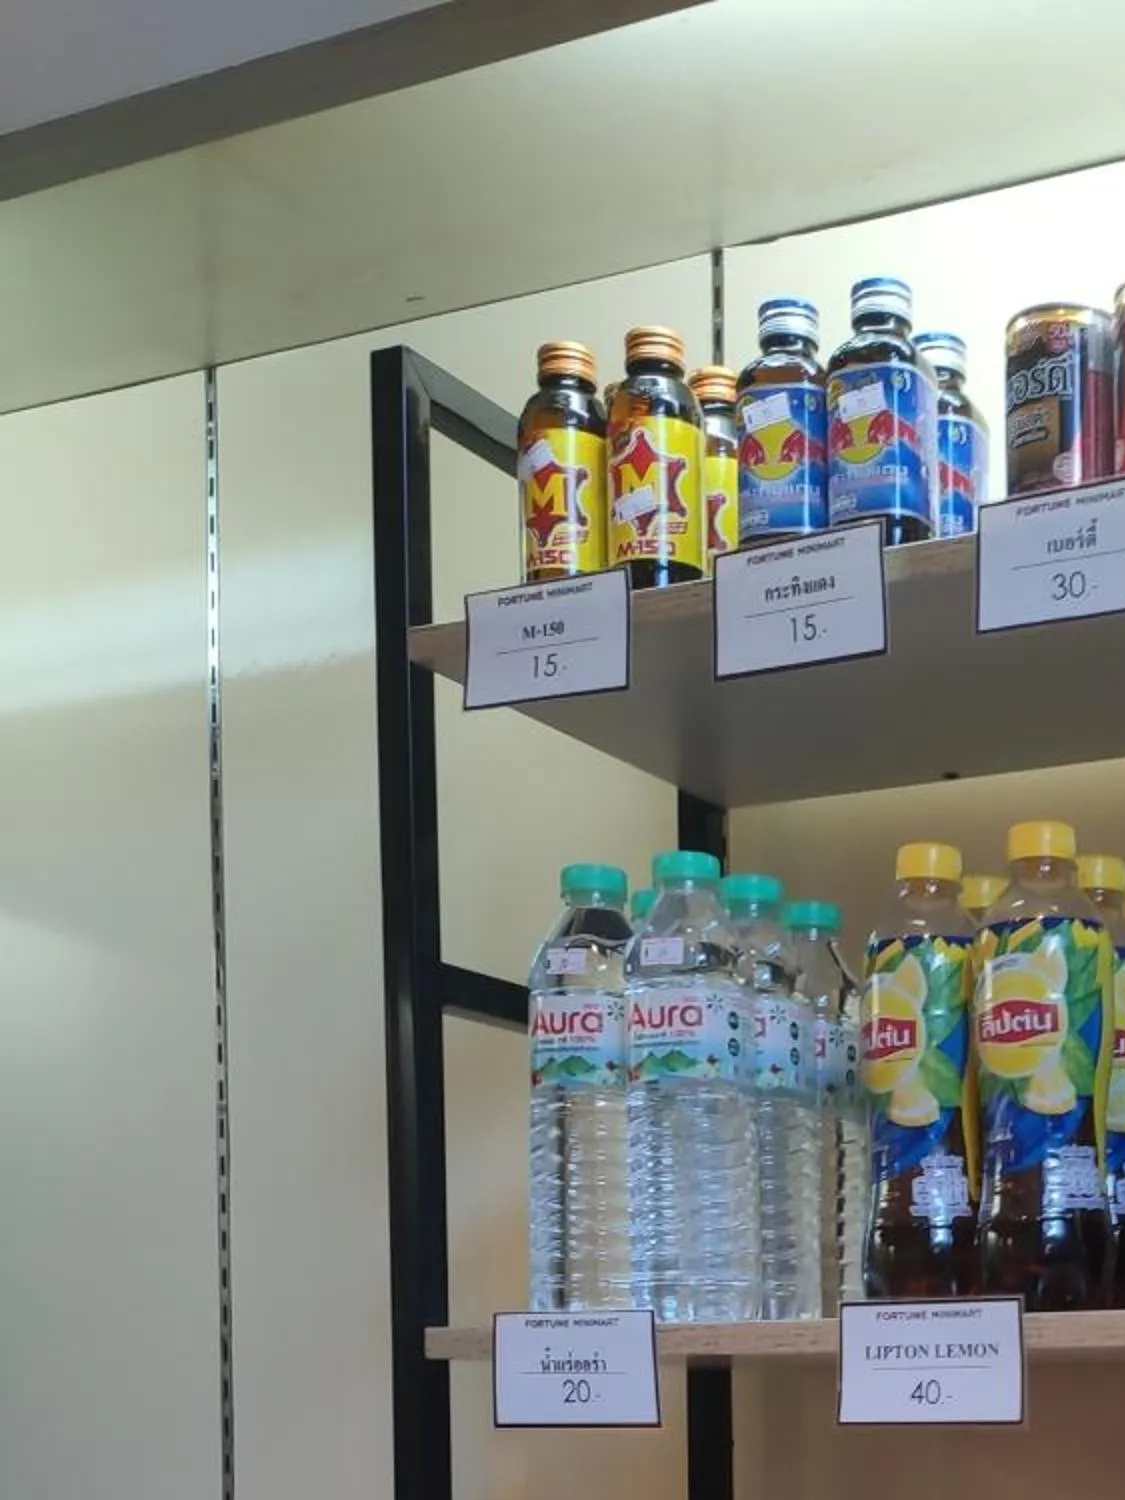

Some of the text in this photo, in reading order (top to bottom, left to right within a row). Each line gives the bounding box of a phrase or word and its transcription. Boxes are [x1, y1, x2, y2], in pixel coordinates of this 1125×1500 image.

[521, 621, 565, 640] M-150
[531, 1009, 604, 1037] Aura
[628, 1003, 703, 1031] Aura
[865, 1342, 1000, 1361] LIPTON LEMON
